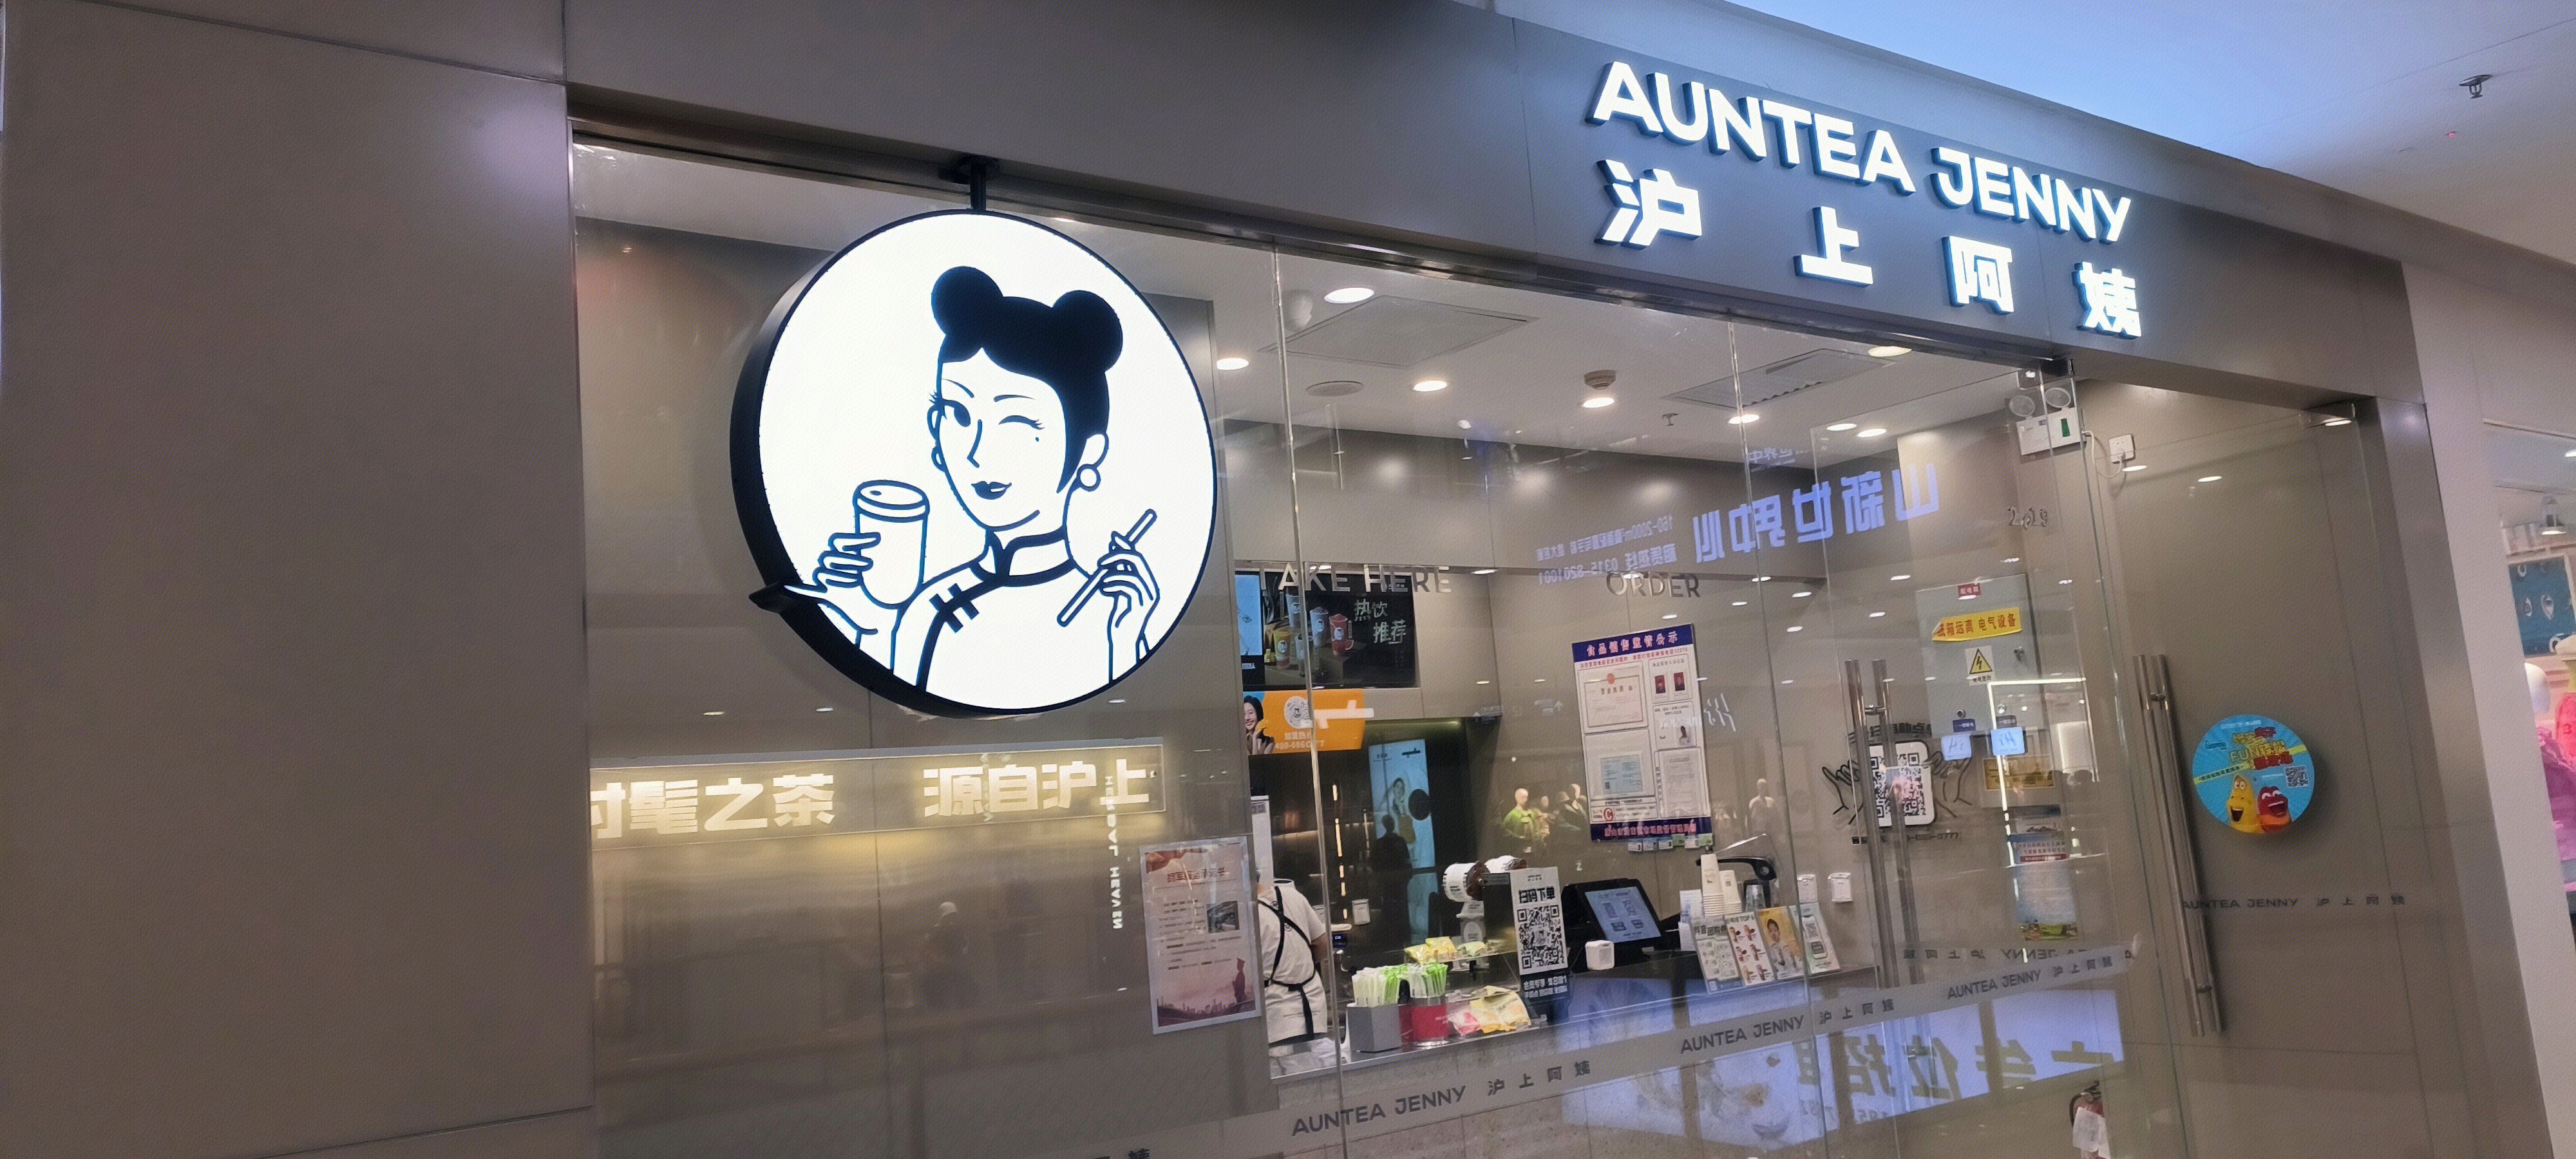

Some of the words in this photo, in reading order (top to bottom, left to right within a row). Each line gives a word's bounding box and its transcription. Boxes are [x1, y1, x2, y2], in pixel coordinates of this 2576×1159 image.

[1587, 61, 1916, 195] AUNTEA
[1932, 147, 2130, 243] JENNY
[1598, 158, 2141, 338] 沪上阿姨
[1255, 562, 1350, 592] TAKE
[1363, 565, 1452, 593] HERE
[1606, 571, 1701, 598] ORDER
[1354, 599, 1387, 621] 热饮
[1978, 613, 2016, 631] 电气设备
[1374, 619, 1406, 645] 推荐
[923, 759, 1150, 816] 源自沪上
[2183, 898, 2240, 909] AUNTEA
[2247, 898, 2298, 909] JENNY
[2316, 894, 2405, 907] 沪上阿姨
[1947, 980, 1998, 999] AUNTEA
[2002, 968, 2042, 988] JENNY
[1680, 1027, 1747, 1055] AUNTEA
[1753, 1015, 1805, 1039] JENNY
[1819, 998, 1895, 1024] 沪上阿姨
[1291, 1103, 1386, 1136] AUNTEA
[1395, 1086, 1466, 1115] JENNY
[1488, 1060, 1591, 1097] 沪上阿姨
